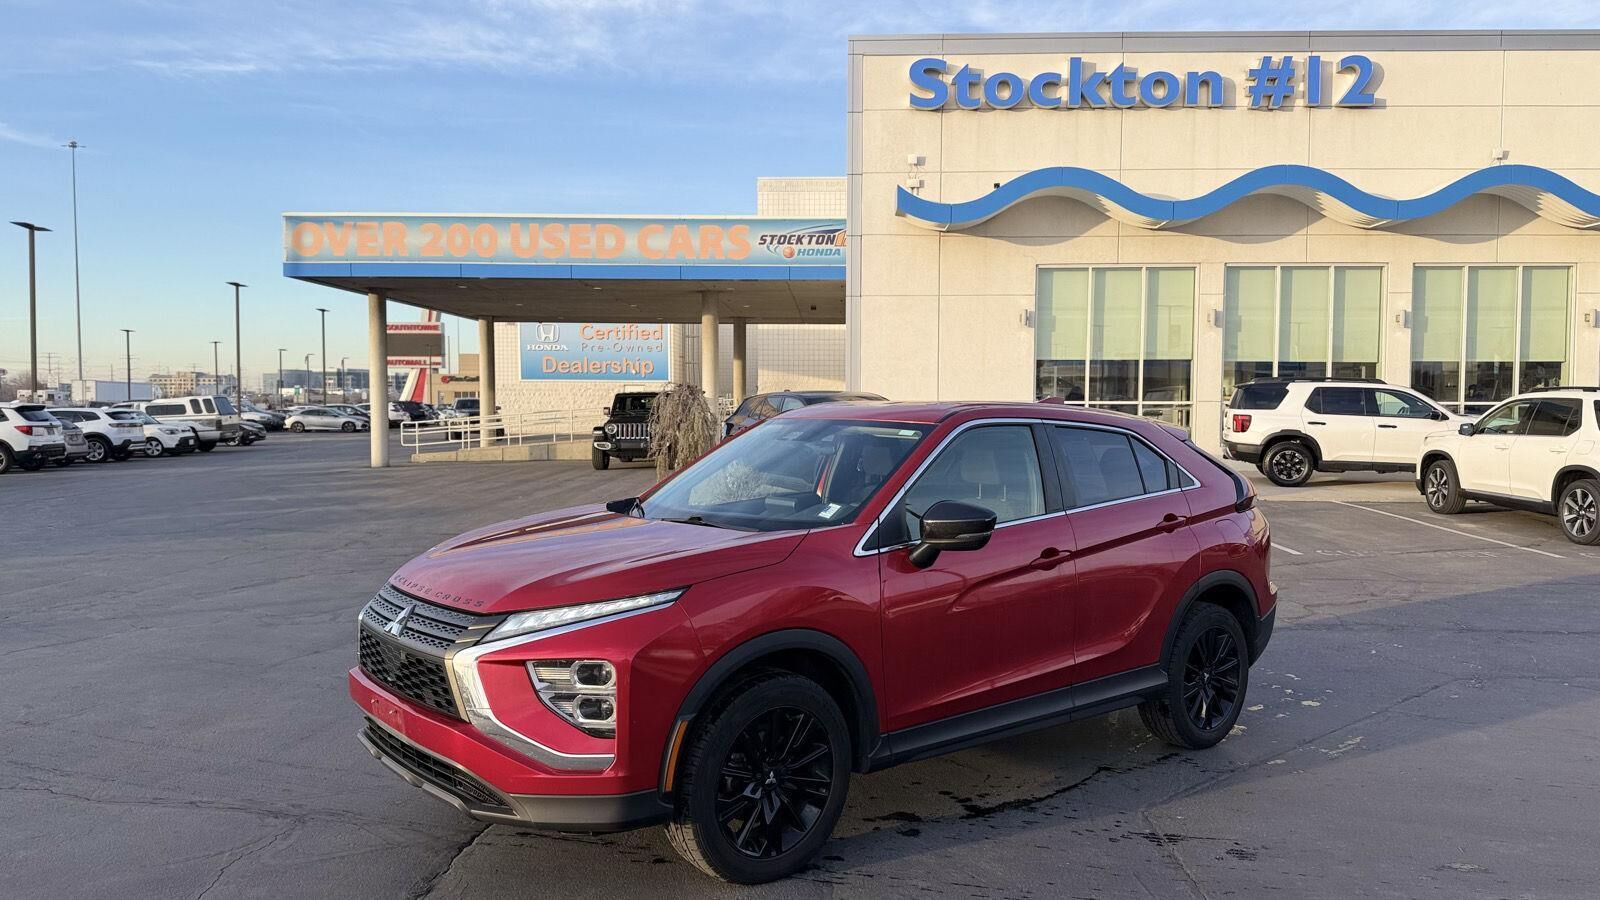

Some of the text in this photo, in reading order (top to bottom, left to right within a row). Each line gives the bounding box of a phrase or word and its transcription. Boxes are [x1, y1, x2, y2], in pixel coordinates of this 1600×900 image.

[908, 54, 1377, 110] Stockton #12
[291, 221, 753, 260] OVER 200 USED CARS
[758, 234, 837, 246] STOCKTON
[796, 248, 841, 257] HONDA
[579, 323, 664, 341] Certified
[527, 344, 569, 352] HONDA
[581, 342, 663, 353] Pre-Owned
[541, 355, 655, 378] Dealership
[435, 591, 485, 608] CROSS
